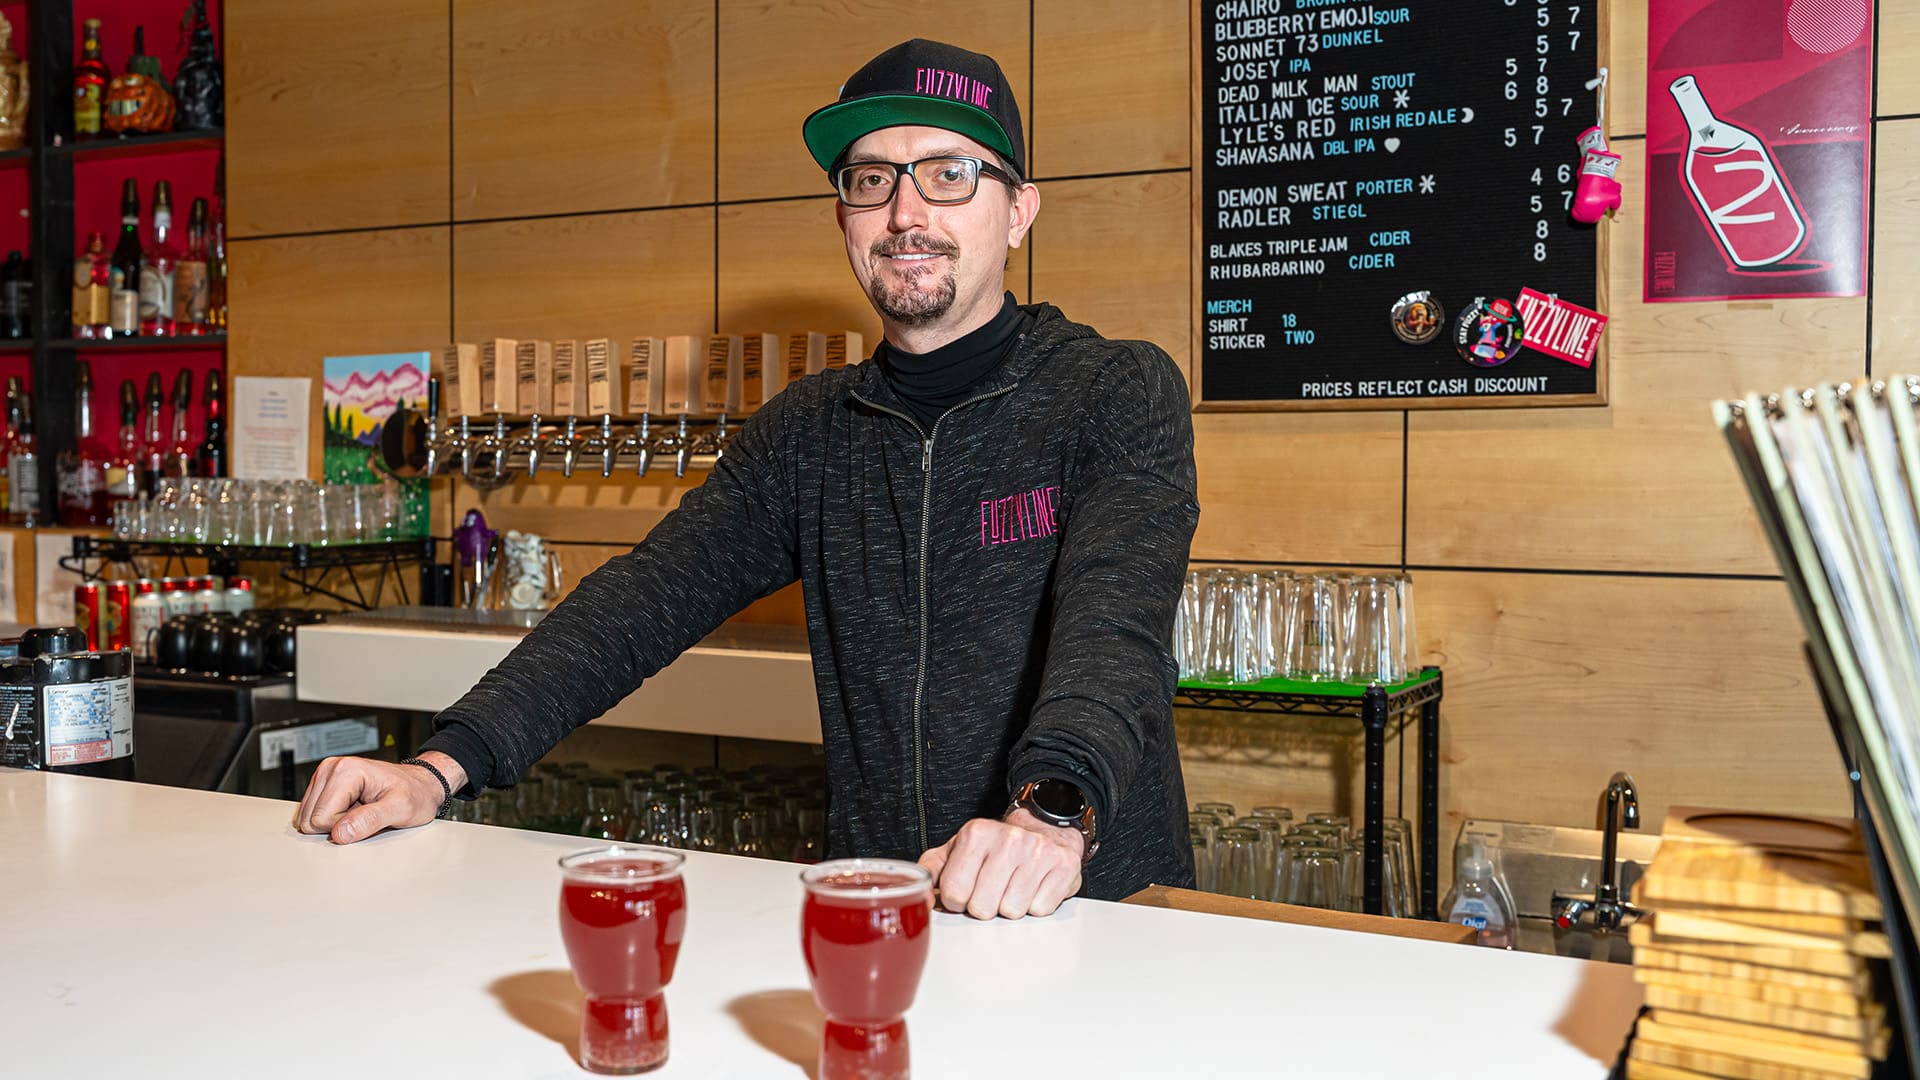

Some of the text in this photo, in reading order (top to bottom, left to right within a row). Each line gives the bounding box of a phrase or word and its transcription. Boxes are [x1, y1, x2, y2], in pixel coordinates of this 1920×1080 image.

[1215, 0, 1281, 20] CHAIRO
[1537, 6, 1581, 27] 5 7
[1215, 5, 1410, 41] BLUEBERRY EMOJI SOUR
[1216, 29, 1383, 62] SONNET 73 DUNKEL
[1536, 31, 1580, 54] 5 7
[1220, 58, 1311, 83] JOSEY IPA
[1505, 57, 1548, 76] 5 7
[1218, 73, 1416, 104] DEAD MILK MAN STOUT
[1504, 75, 1549, 101] 6 8
[1341, 94, 1380, 111] SOUR
[1535, 98, 1573, 117] 5 7
[1221, 108, 1457, 145] LYLE'S RED IRISH RED ALE
[1505, 125, 1545, 147] 5 7
[1216, 138, 1376, 167] SHAVASANA DBL IPA
[1531, 164, 1571, 186] 4 6
[1218, 178, 1413, 209] DEMON SWEAT PORTER
[1530, 191, 1574, 213] 5 7
[1218, 203, 1367, 230] RADLER STIEGL
[1536, 220, 1549, 239] 8
[1210, 230, 1411, 259] BLAKES TRIPLE JAM CIDER
[1534, 242, 1547, 262] 8
[1210, 259, 1326, 280] RHUBARBARINO
[1207, 299, 1252, 315] MERCH
[1208, 313, 1297, 333] SHIRT 18
[1209, 330, 1315, 351] STICKER TWO
[1302, 376, 1548, 397] PRICES REFLECT CASH DISCOUNT
[981, 485, 1059, 546] FUZZYLINE
